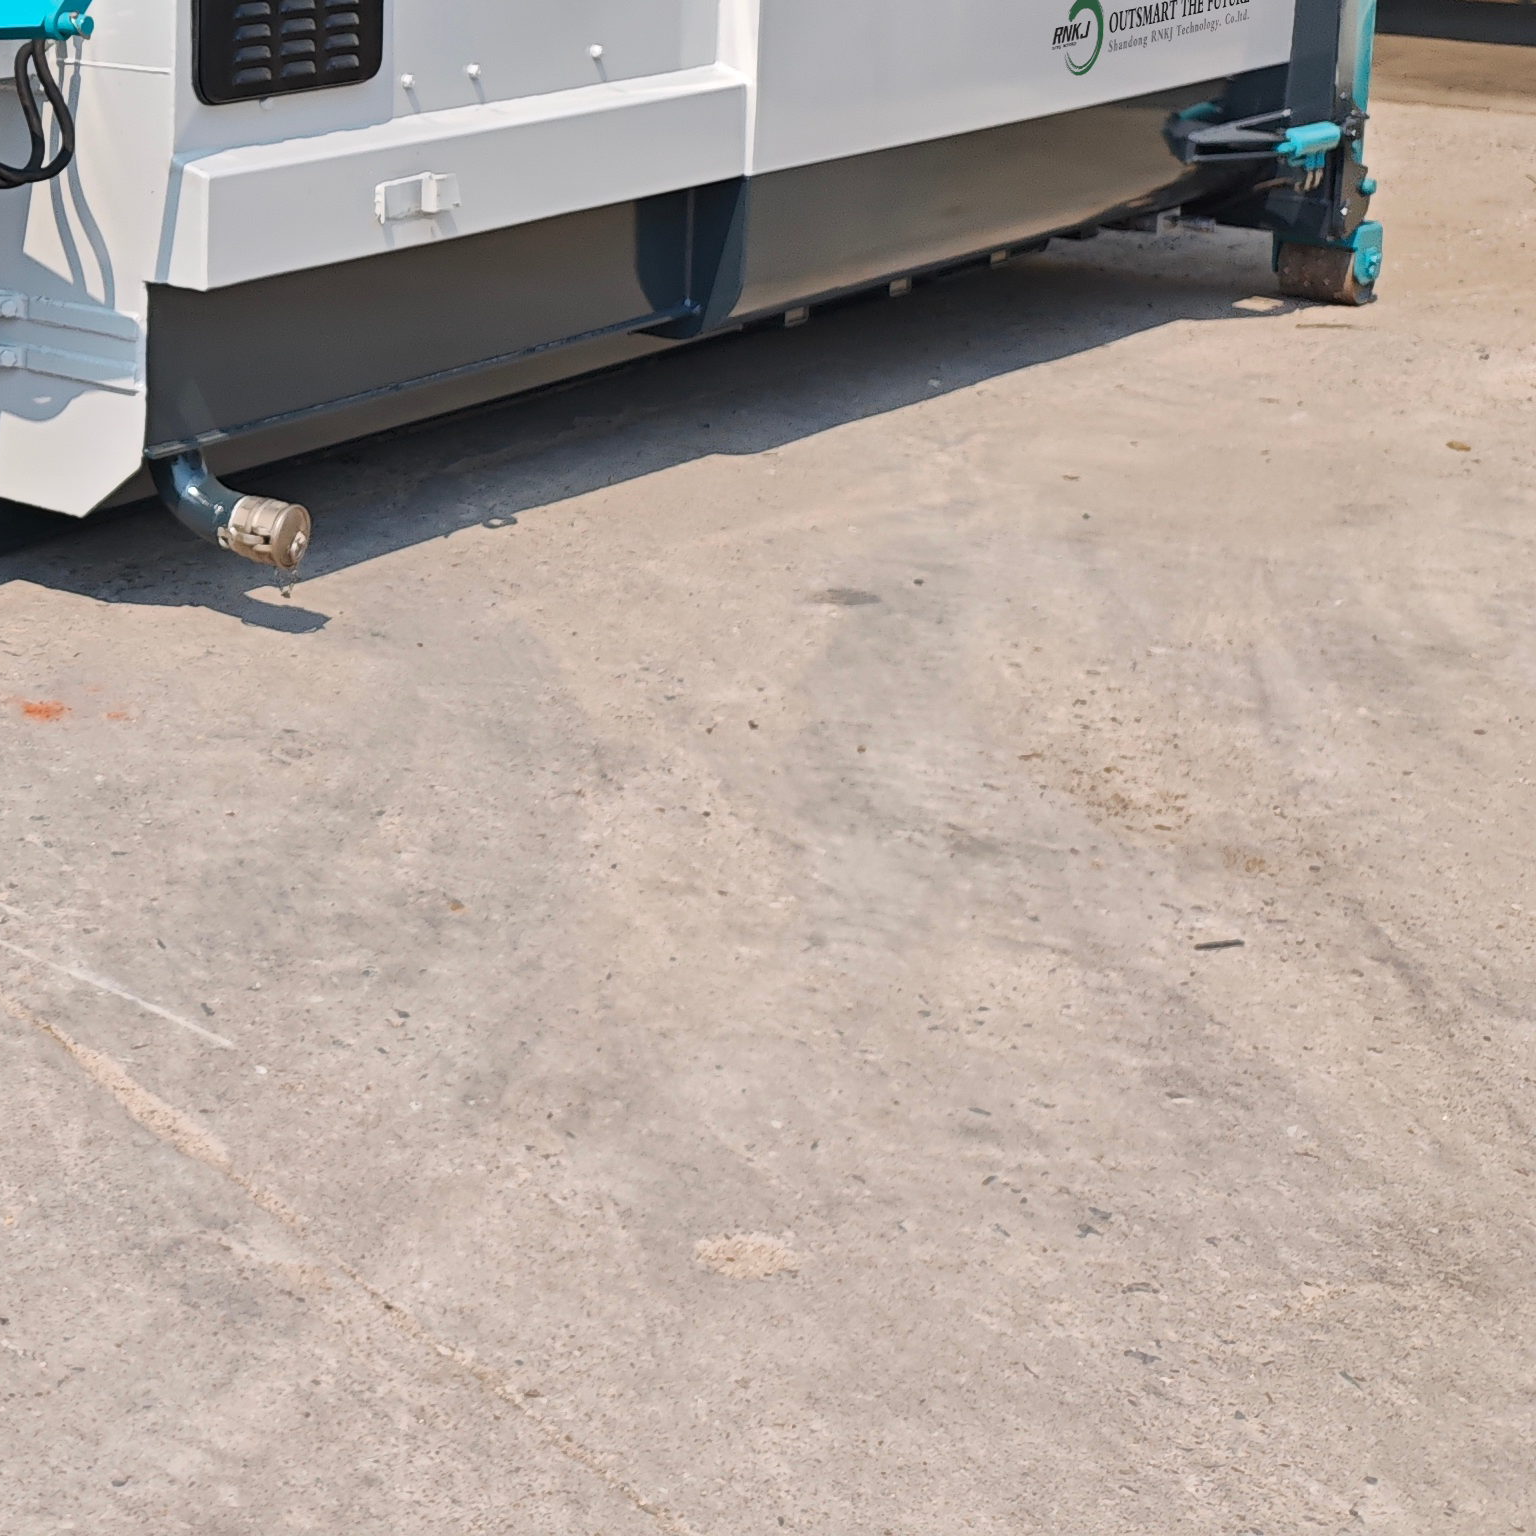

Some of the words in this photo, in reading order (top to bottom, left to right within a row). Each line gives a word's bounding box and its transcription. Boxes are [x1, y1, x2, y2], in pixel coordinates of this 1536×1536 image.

[1052, 21, 1091, 45] RNKJ
[1107, 34, 1148, 53] Shandong
[1151, 26, 1173, 42] RNKJ
